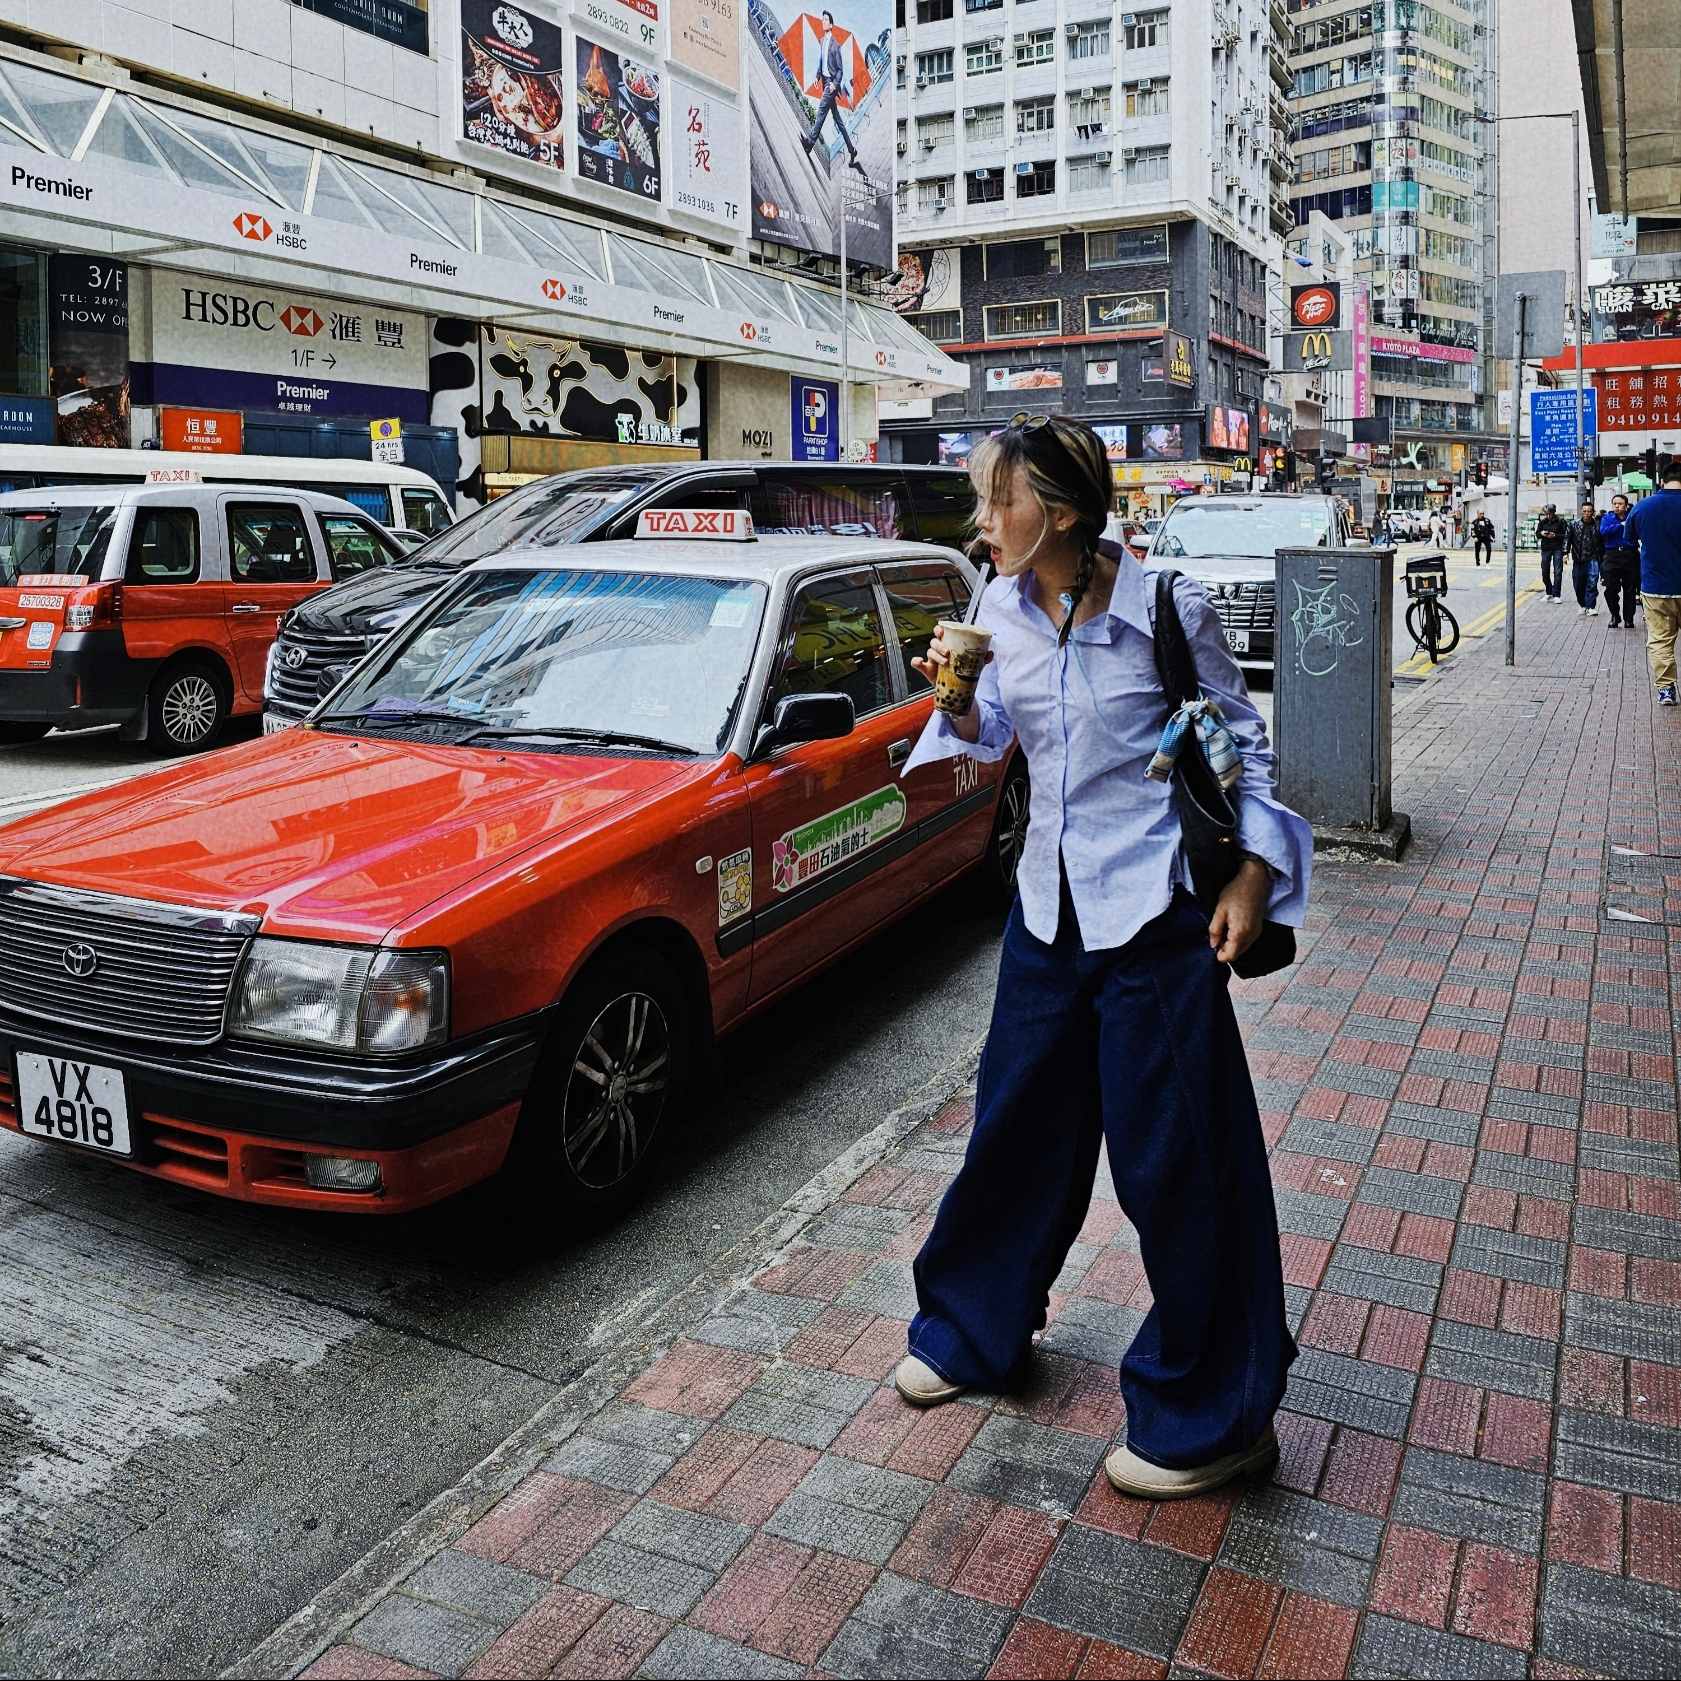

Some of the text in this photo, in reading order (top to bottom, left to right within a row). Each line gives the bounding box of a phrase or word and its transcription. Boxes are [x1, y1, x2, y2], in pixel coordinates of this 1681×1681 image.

[381, 7, 403, 24] ROOM
[587, 4, 629, 35] 2893 0822
[497, 9, 529, 40] 牛大人
[640, 24, 655, 45] 9F
[540, 139, 559, 162] 5F
[11, 165, 93, 202] Premier
[643, 175, 659, 195] 6F
[678, 192, 715, 213] 2893 1038
[724, 201, 738, 220] 7F
[276, 233, 307, 250] HSBC
[410, 253, 458, 277] Premier
[88, 265, 123, 291] 3/F
[60, 293, 87, 303] TEL:
[94, 296, 119, 308] 2897
[567, 294, 588, 307] HSBC
[1302, 302, 1326, 315] Pizza
[1598, 301, 1673, 314] SUAN CAI
[61, 310, 106, 324] NOW
[181, 288, 276, 331] HSBC
[653, 305, 685, 324] Premier
[1306, 308, 1325, 320] Hut
[757, 333, 772, 344] HSBC
[815, 340, 838, 354] Premier
[1382, 340, 1420, 355] KYOTO PLAZA
[291, 349, 315, 368] 1/F
[926, 363, 943, 376] Premier
[277, 380, 330, 400] Premier
[278, 401, 312, 413] 卓越理財
[1537, 399, 1590, 408] 行人專用區劃
[3, 410, 33, 423] ROOM
[1607, 413, 1646, 426] 9419
[186, 418, 217, 435] 恒豐
[637, 423, 681, 443] 牛奶冰室
[1545, 427, 1578, 435] 星期一至
[375, 441, 399, 450] 24 hrs
[742, 429, 773, 448] MOZI
[379, 450, 398, 461] 全日
[151, 470, 190, 481] TAXI
[645, 511, 735, 533] TAXI
[21, 595, 61, 607] 25700328
[953, 758, 978, 797] TAXI
[798, 827, 869, 881] 豐田石油氣的士
[47, 1058, 95, 1104] VX
[34, 1095, 114, 1148] 4818
